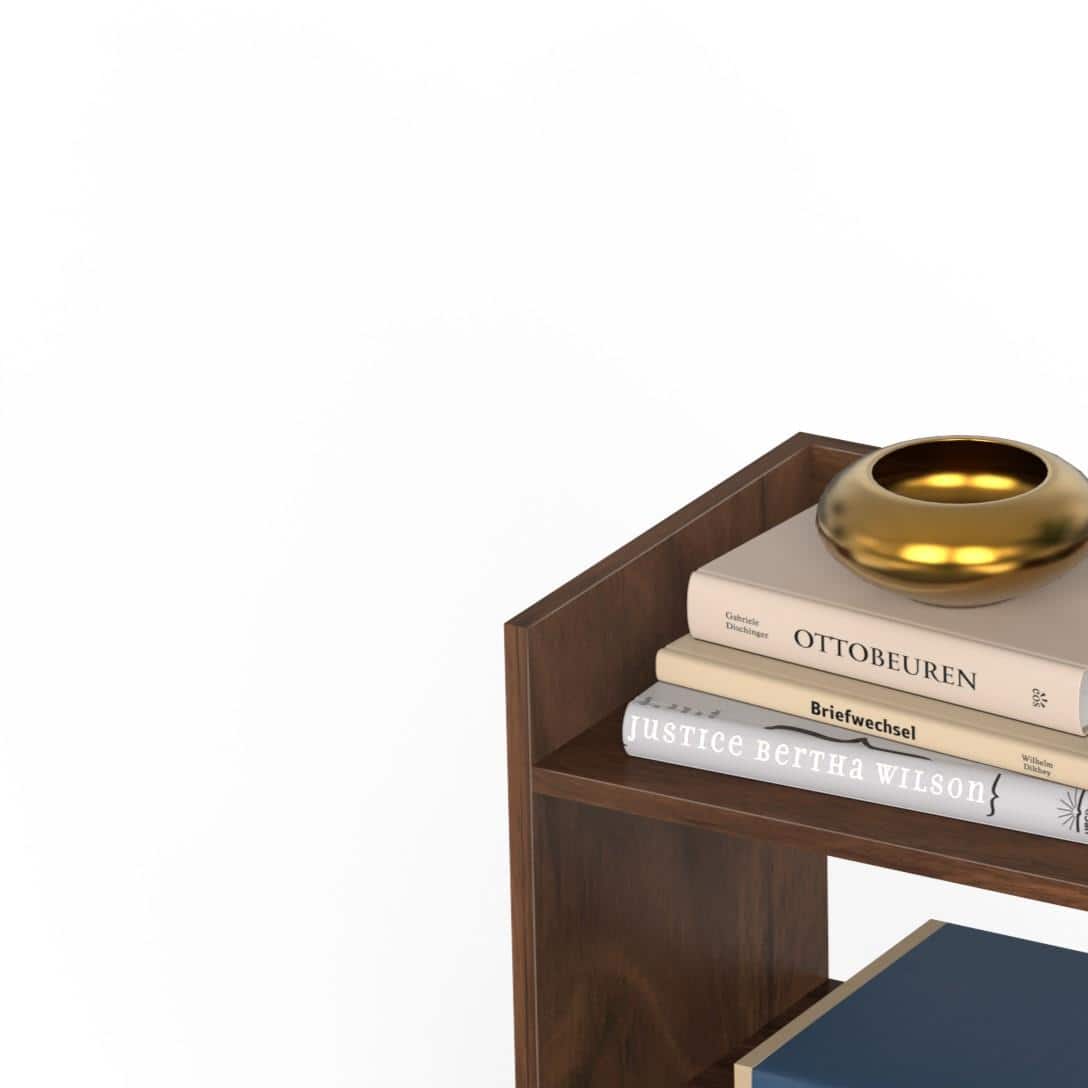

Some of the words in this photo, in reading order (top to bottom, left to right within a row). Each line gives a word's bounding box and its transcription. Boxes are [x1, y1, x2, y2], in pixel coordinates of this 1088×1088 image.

[793, 628, 977, 692] OTTOBEUREN
[810, 700, 916, 740] Briefwechsel
[1021, 753, 1054, 769] Wilhelm
